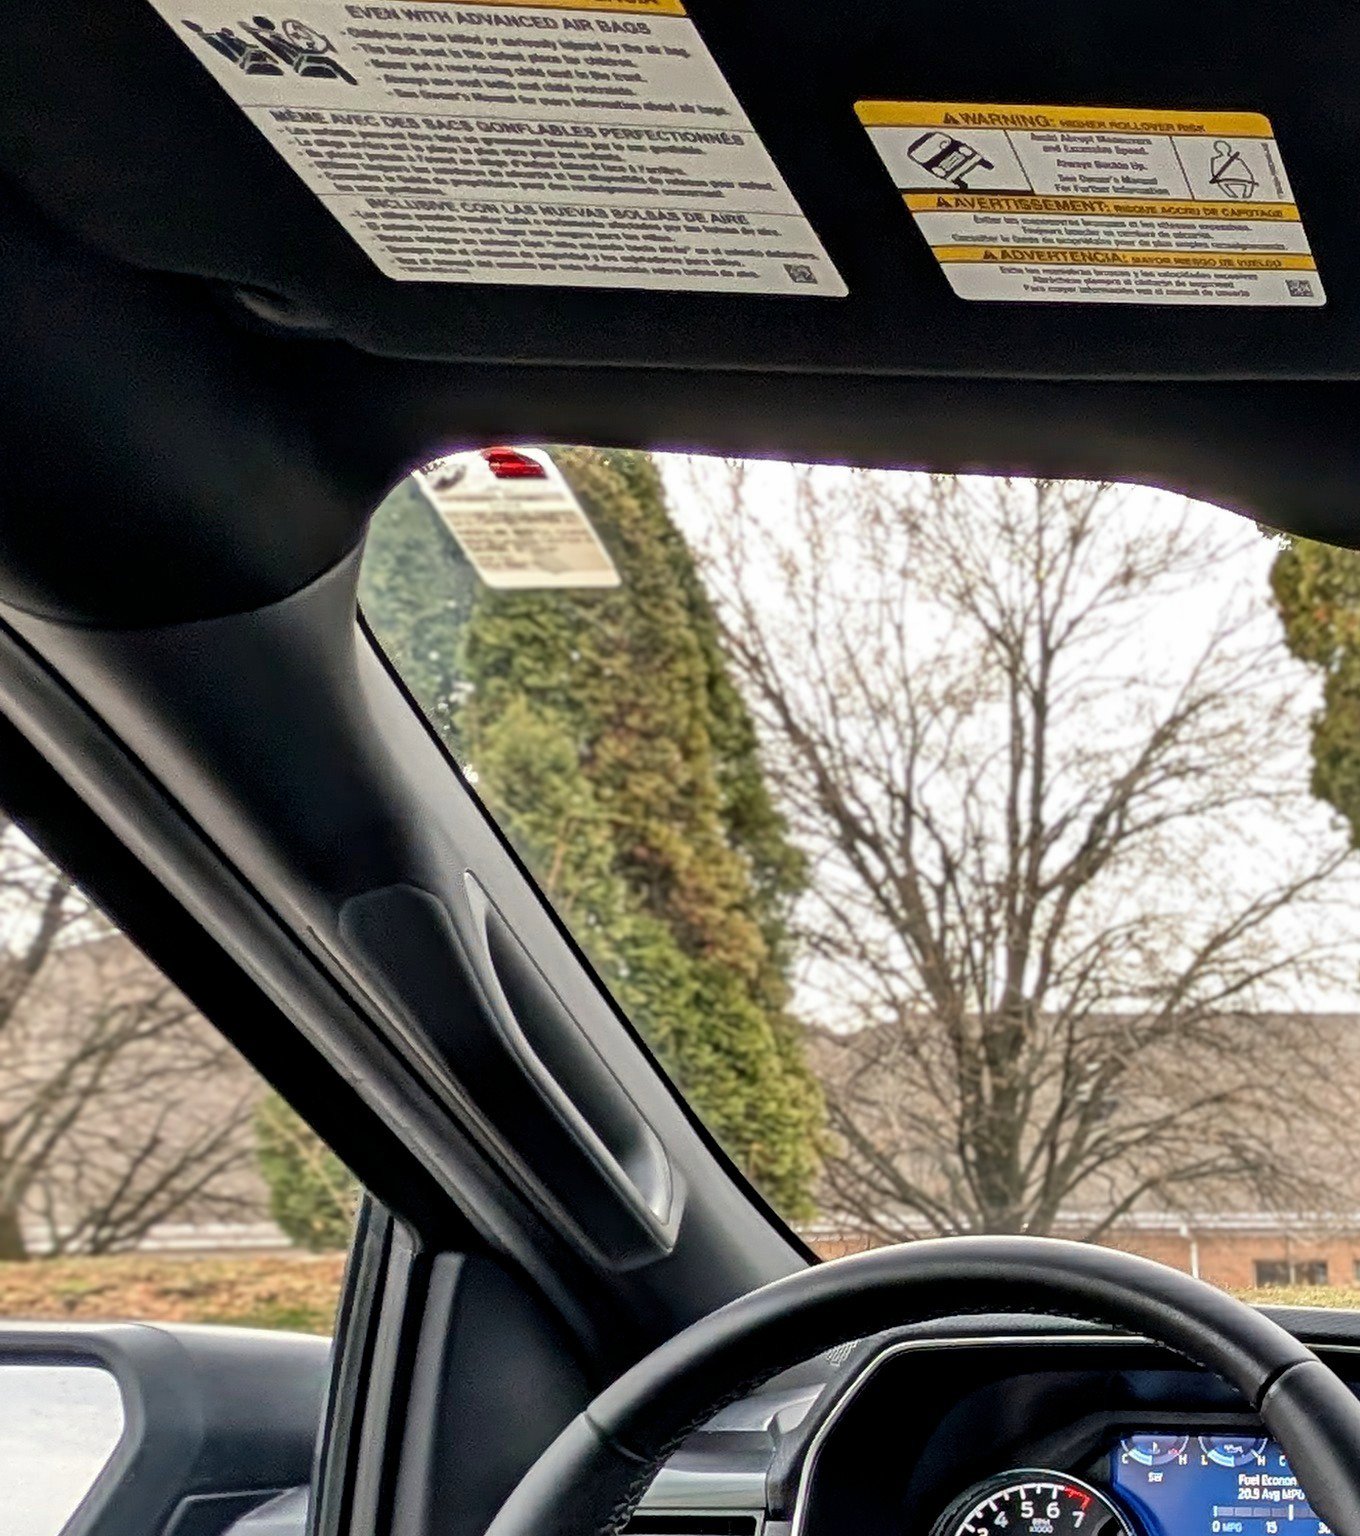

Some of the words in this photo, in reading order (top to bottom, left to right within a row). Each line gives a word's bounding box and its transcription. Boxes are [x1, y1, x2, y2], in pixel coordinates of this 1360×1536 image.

[346, 5, 398, 21] EVEN
[402, 8, 456, 25] WITH
[457, 11, 559, 30] ADVANCED
[562, 17, 597, 32] AIR
[599, 19, 652, 35] BAGS
[330, 112, 381, 127] AVEC
[380, 115, 420, 129] DES
[422, 118, 474, 132] SACS
[475, 120, 597, 138] GONFLABLES
[960, 111, 1054, 127] WARNING:
[1108, 120, 1177, 132] ROLLOVER
[365, 198, 459, 213] INCLUSIVE
[460, 202, 499, 214] CON
[501, 203, 537, 215] LAS
[538, 204, 610, 219] NUEVAS
[610, 207, 681, 222] BOLSAS
[681, 211, 708, 223] DE
[710, 212, 751, 225] AIRE
[954, 199, 1110, 213] AVERTISSEMENT:
[1000, 250, 1127, 263] ADVERTENCIA:
[1238, 1474, 1260, 1487] Fuel
[1262, 1475, 1297, 1487] Econom
[1237, 1488, 1260, 1500] 20.9
[1262, 1489, 1280, 1502] Avg
[1021, 1501, 1034, 1518] 5
[1046, 1501, 1060, 1519] 6
[994, 1511, 1009, 1528] 4
[1072, 1511, 1086, 1528] 7
[1266, 1523, 1278, 1534] 15
